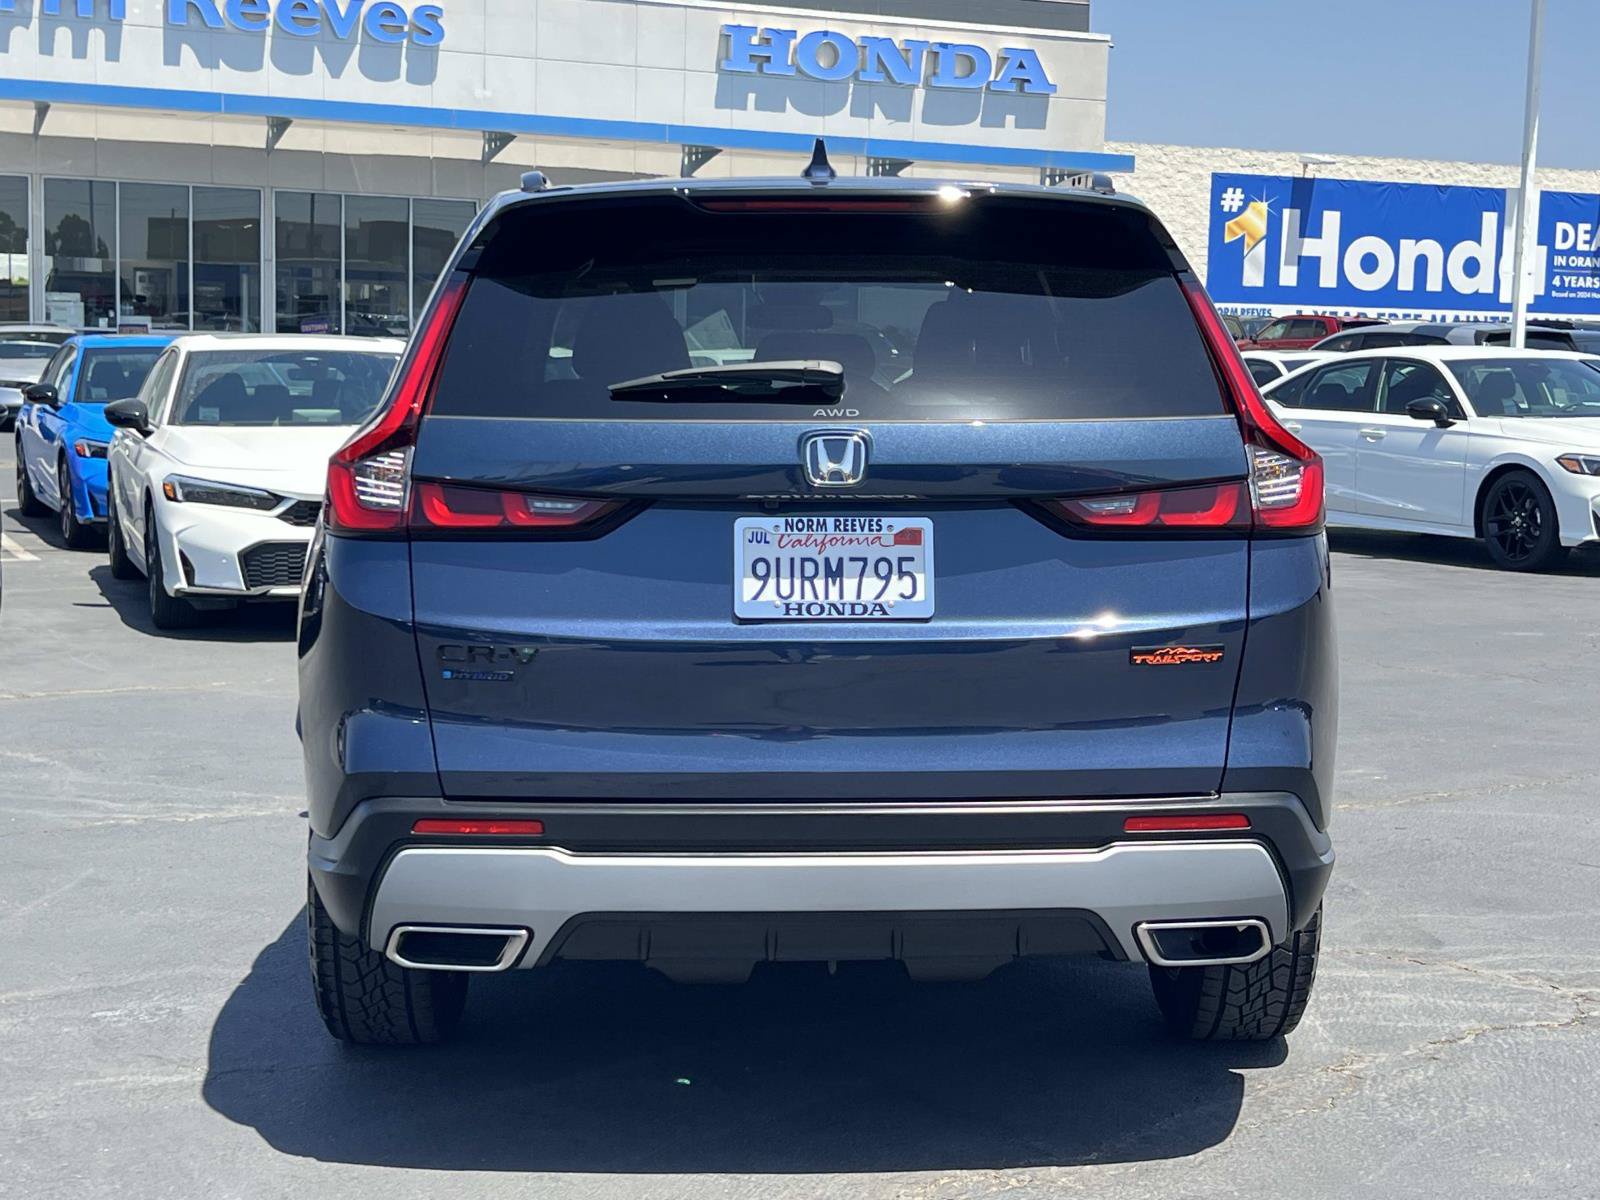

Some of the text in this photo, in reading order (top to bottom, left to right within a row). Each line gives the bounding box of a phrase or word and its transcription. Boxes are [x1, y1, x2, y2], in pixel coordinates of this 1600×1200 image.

[720, 24, 1057, 94] HONDA
[1278, 207, 1547, 297] Hond
[1553, 255, 1567, 266] IN
[1552, 275, 1600, 288] 4 YEARS
[813, 408, 860, 417] AWD
[784, 518, 883, 533] NORM REEVES
[748, 531, 770, 545] JUL
[777, 533, 895, 555] California
[751, 556, 918, 601] 9URM795
[782, 602, 891, 617] HONDA
